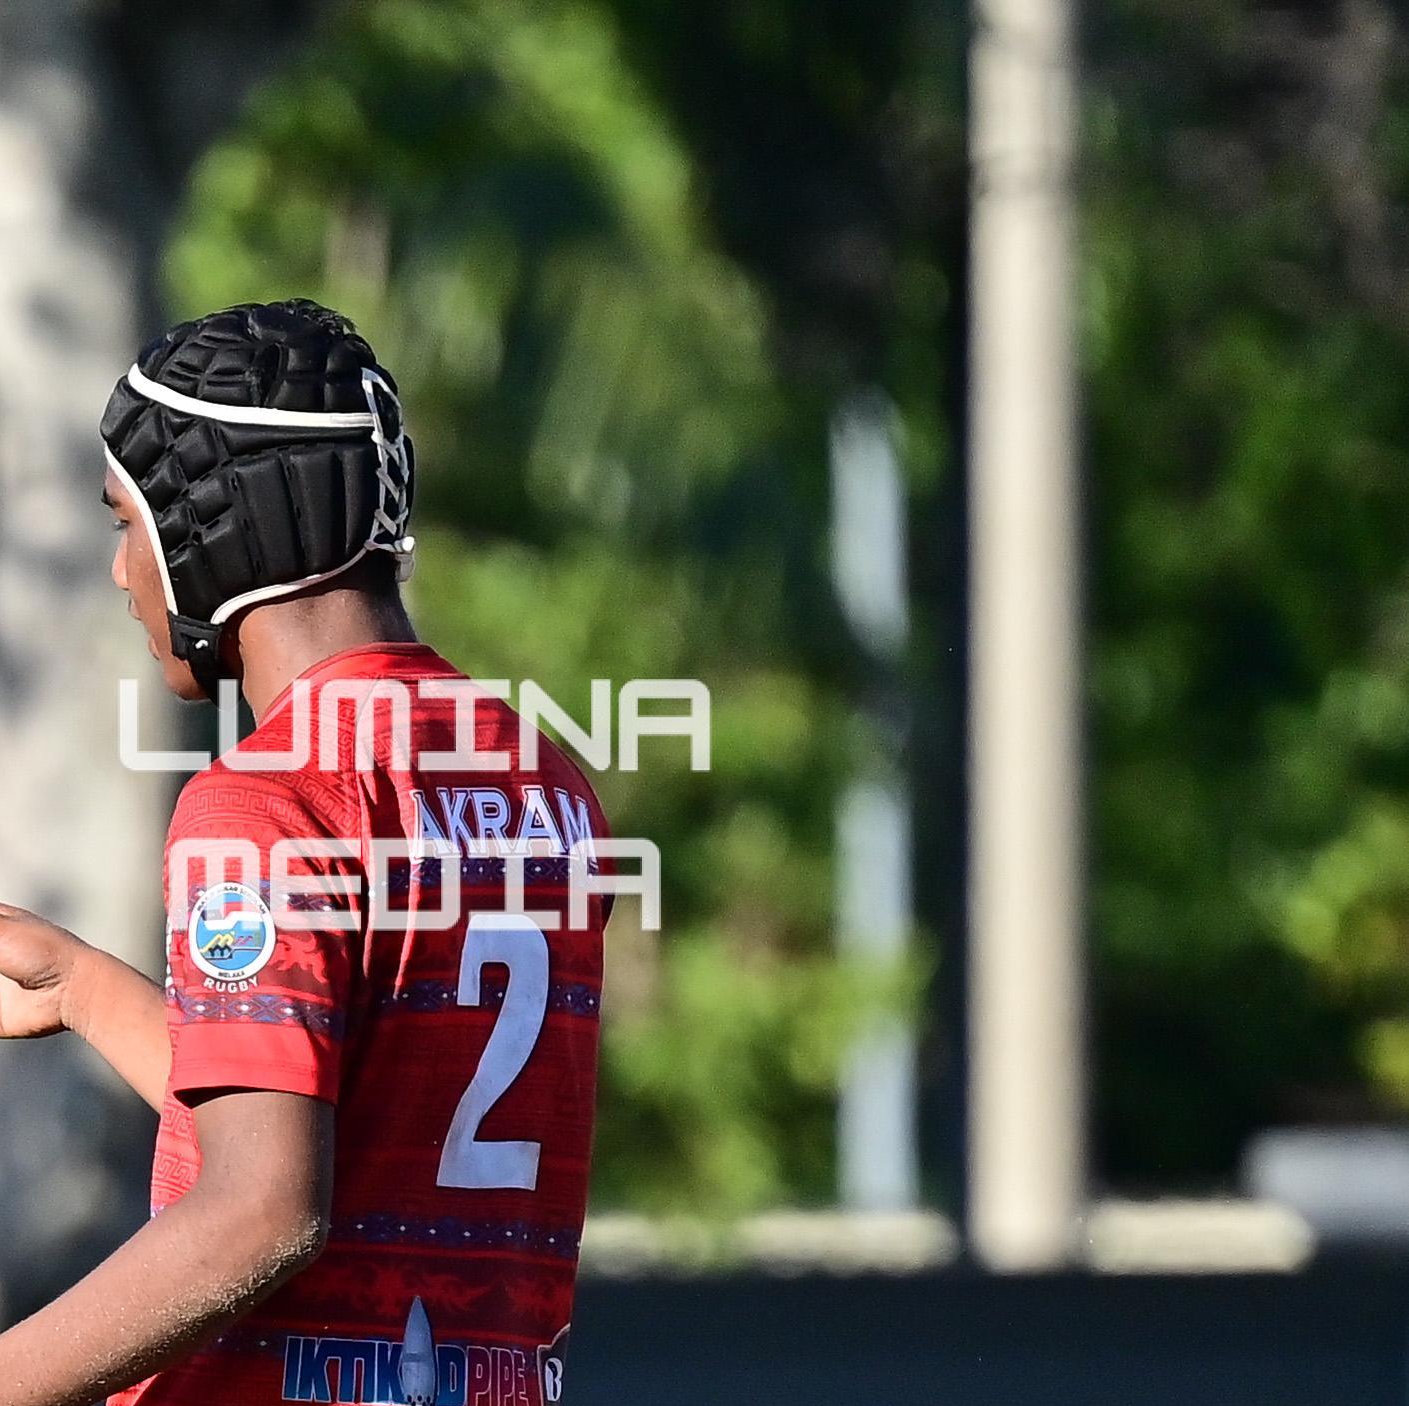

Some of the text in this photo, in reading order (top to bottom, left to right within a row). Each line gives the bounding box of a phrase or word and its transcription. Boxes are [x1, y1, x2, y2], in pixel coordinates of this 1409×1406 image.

[409, 784, 599, 870] AKRAM
[203, 976, 259, 994] RUGBY
[436, 914, 549, 1190] 2
